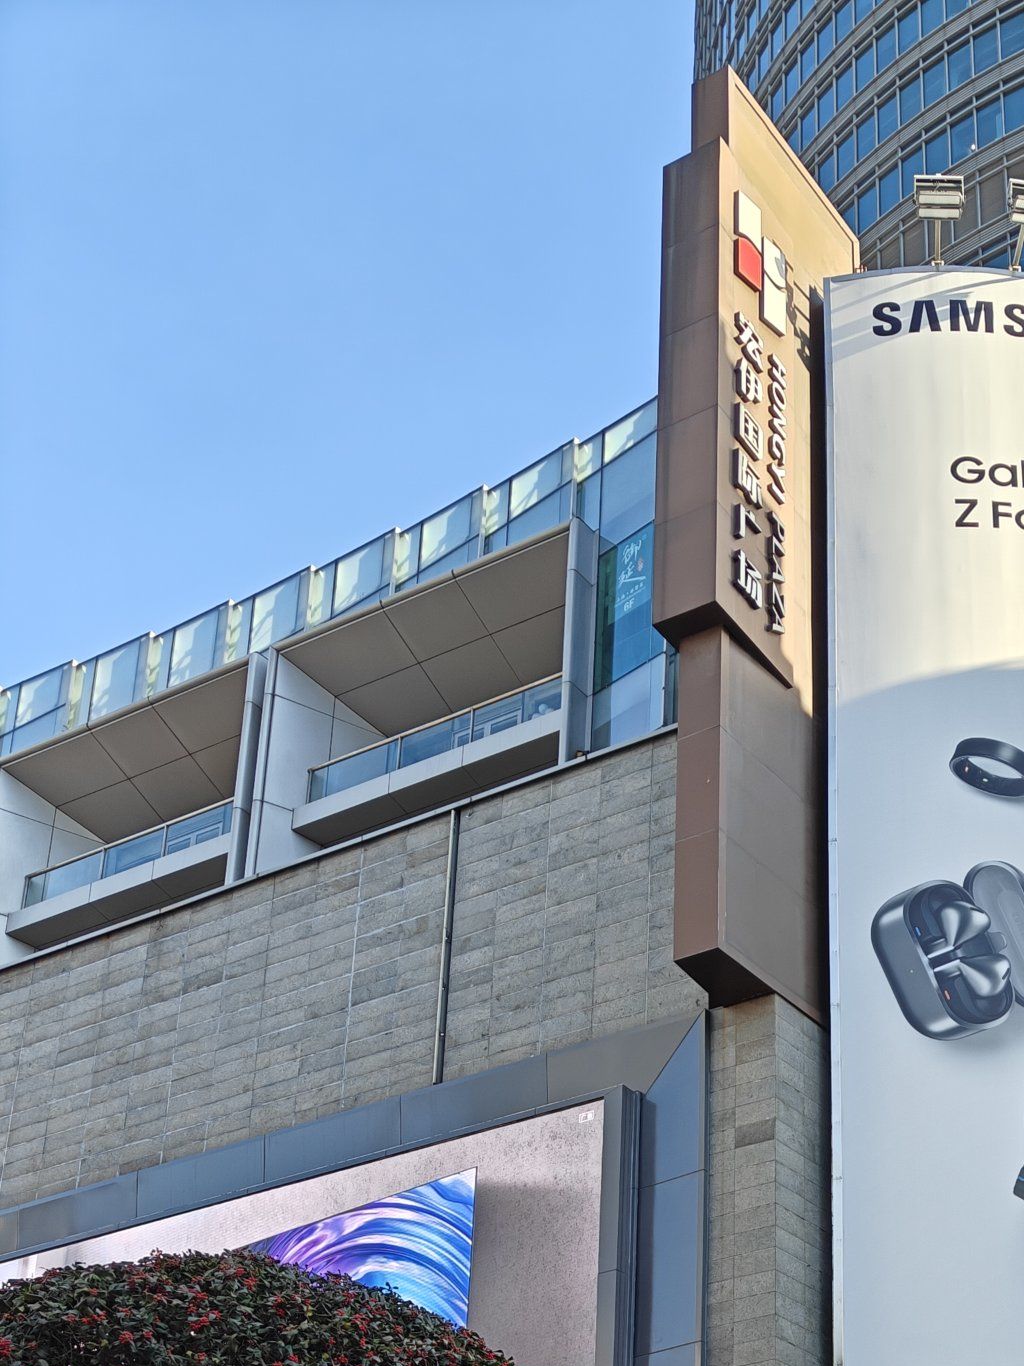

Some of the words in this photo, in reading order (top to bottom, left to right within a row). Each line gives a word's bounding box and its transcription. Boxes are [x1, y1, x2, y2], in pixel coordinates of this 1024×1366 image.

[734, 311, 763, 610] 宏伊国际广场
[767, 353, 787, 504] HONGYI
[765, 511, 785, 634] PLAZA
[954, 499, 979, 527] Z
